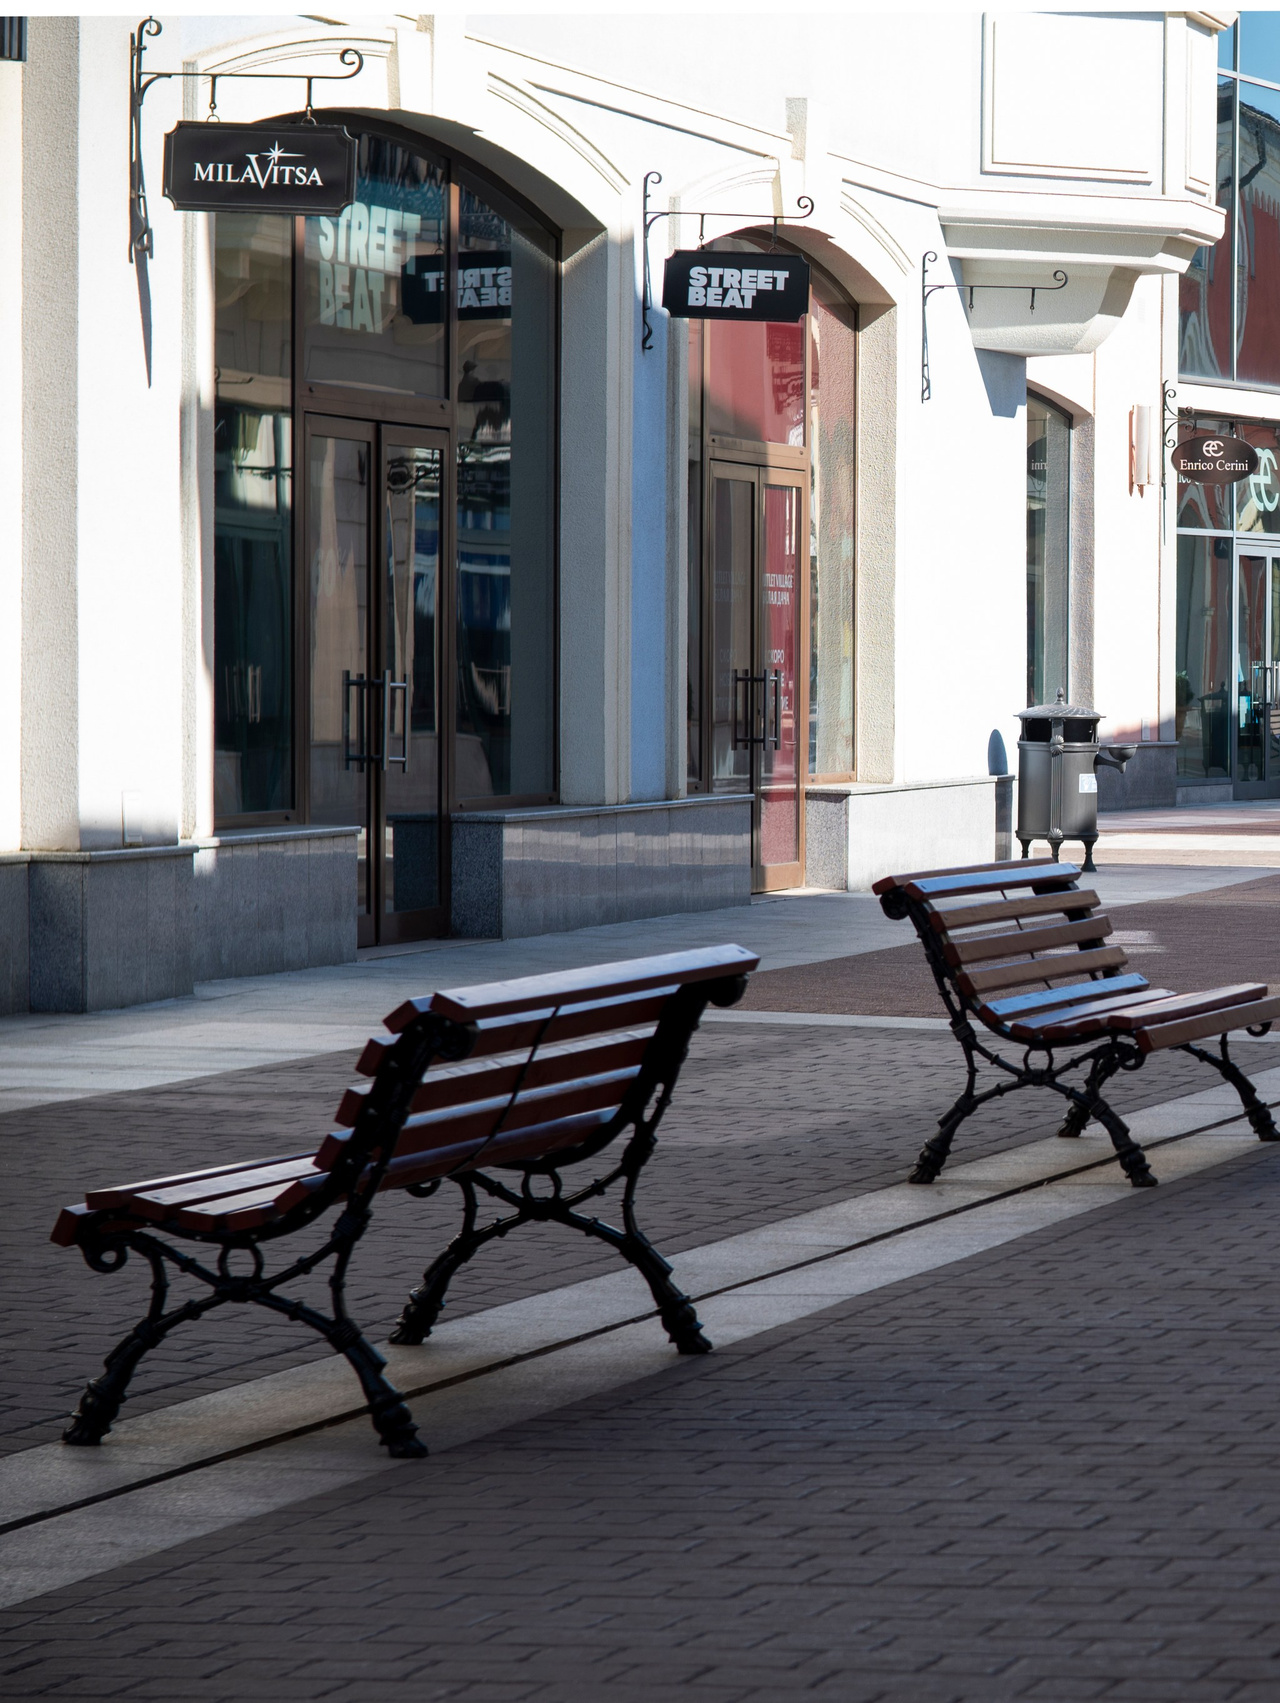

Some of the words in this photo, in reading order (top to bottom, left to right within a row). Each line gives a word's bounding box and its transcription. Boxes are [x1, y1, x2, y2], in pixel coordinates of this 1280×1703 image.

[193, 153, 324, 189] MILAVITSA
[319, 201, 421, 275] STREET
[689, 266, 789, 291] STREET
[319, 260, 385, 334] BEAT
[687, 286, 757, 309] BEAT
[1180, 459, 1214, 471] Enrico
[1216, 459, 1249, 471] Cerini
